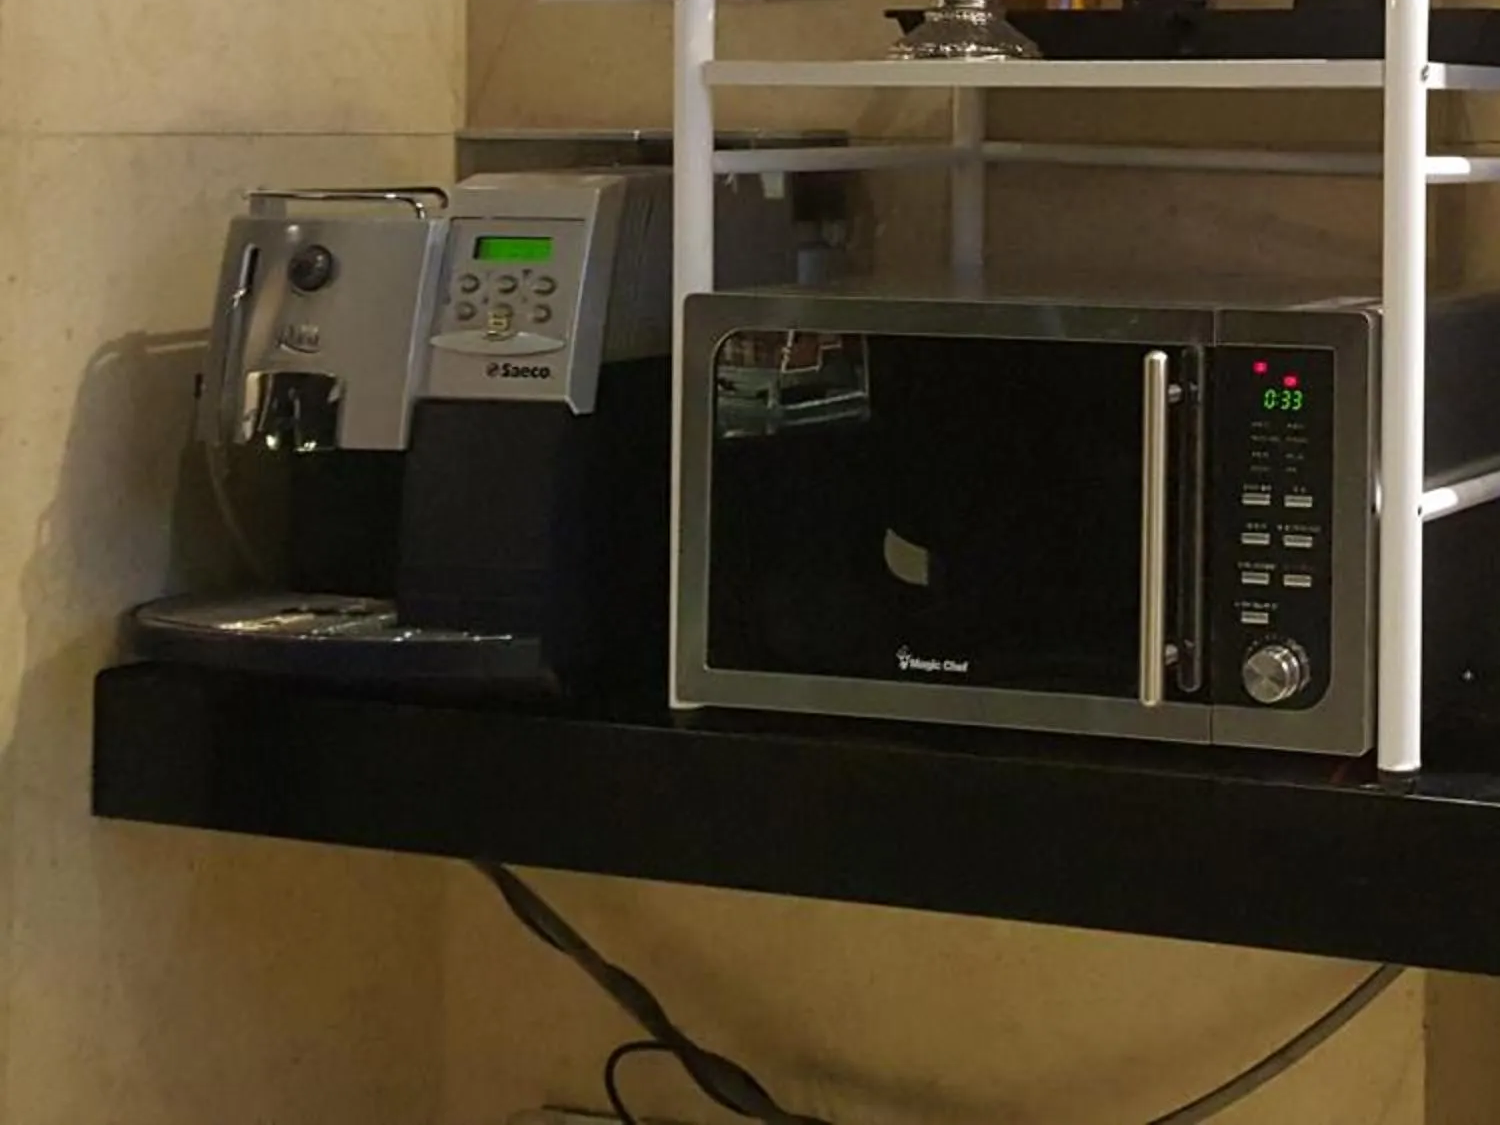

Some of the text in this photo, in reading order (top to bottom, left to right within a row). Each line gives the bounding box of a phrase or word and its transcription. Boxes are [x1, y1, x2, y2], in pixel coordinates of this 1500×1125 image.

[501, 362, 551, 379] Saeco
[909, 657, 969, 672] Magic Chef
